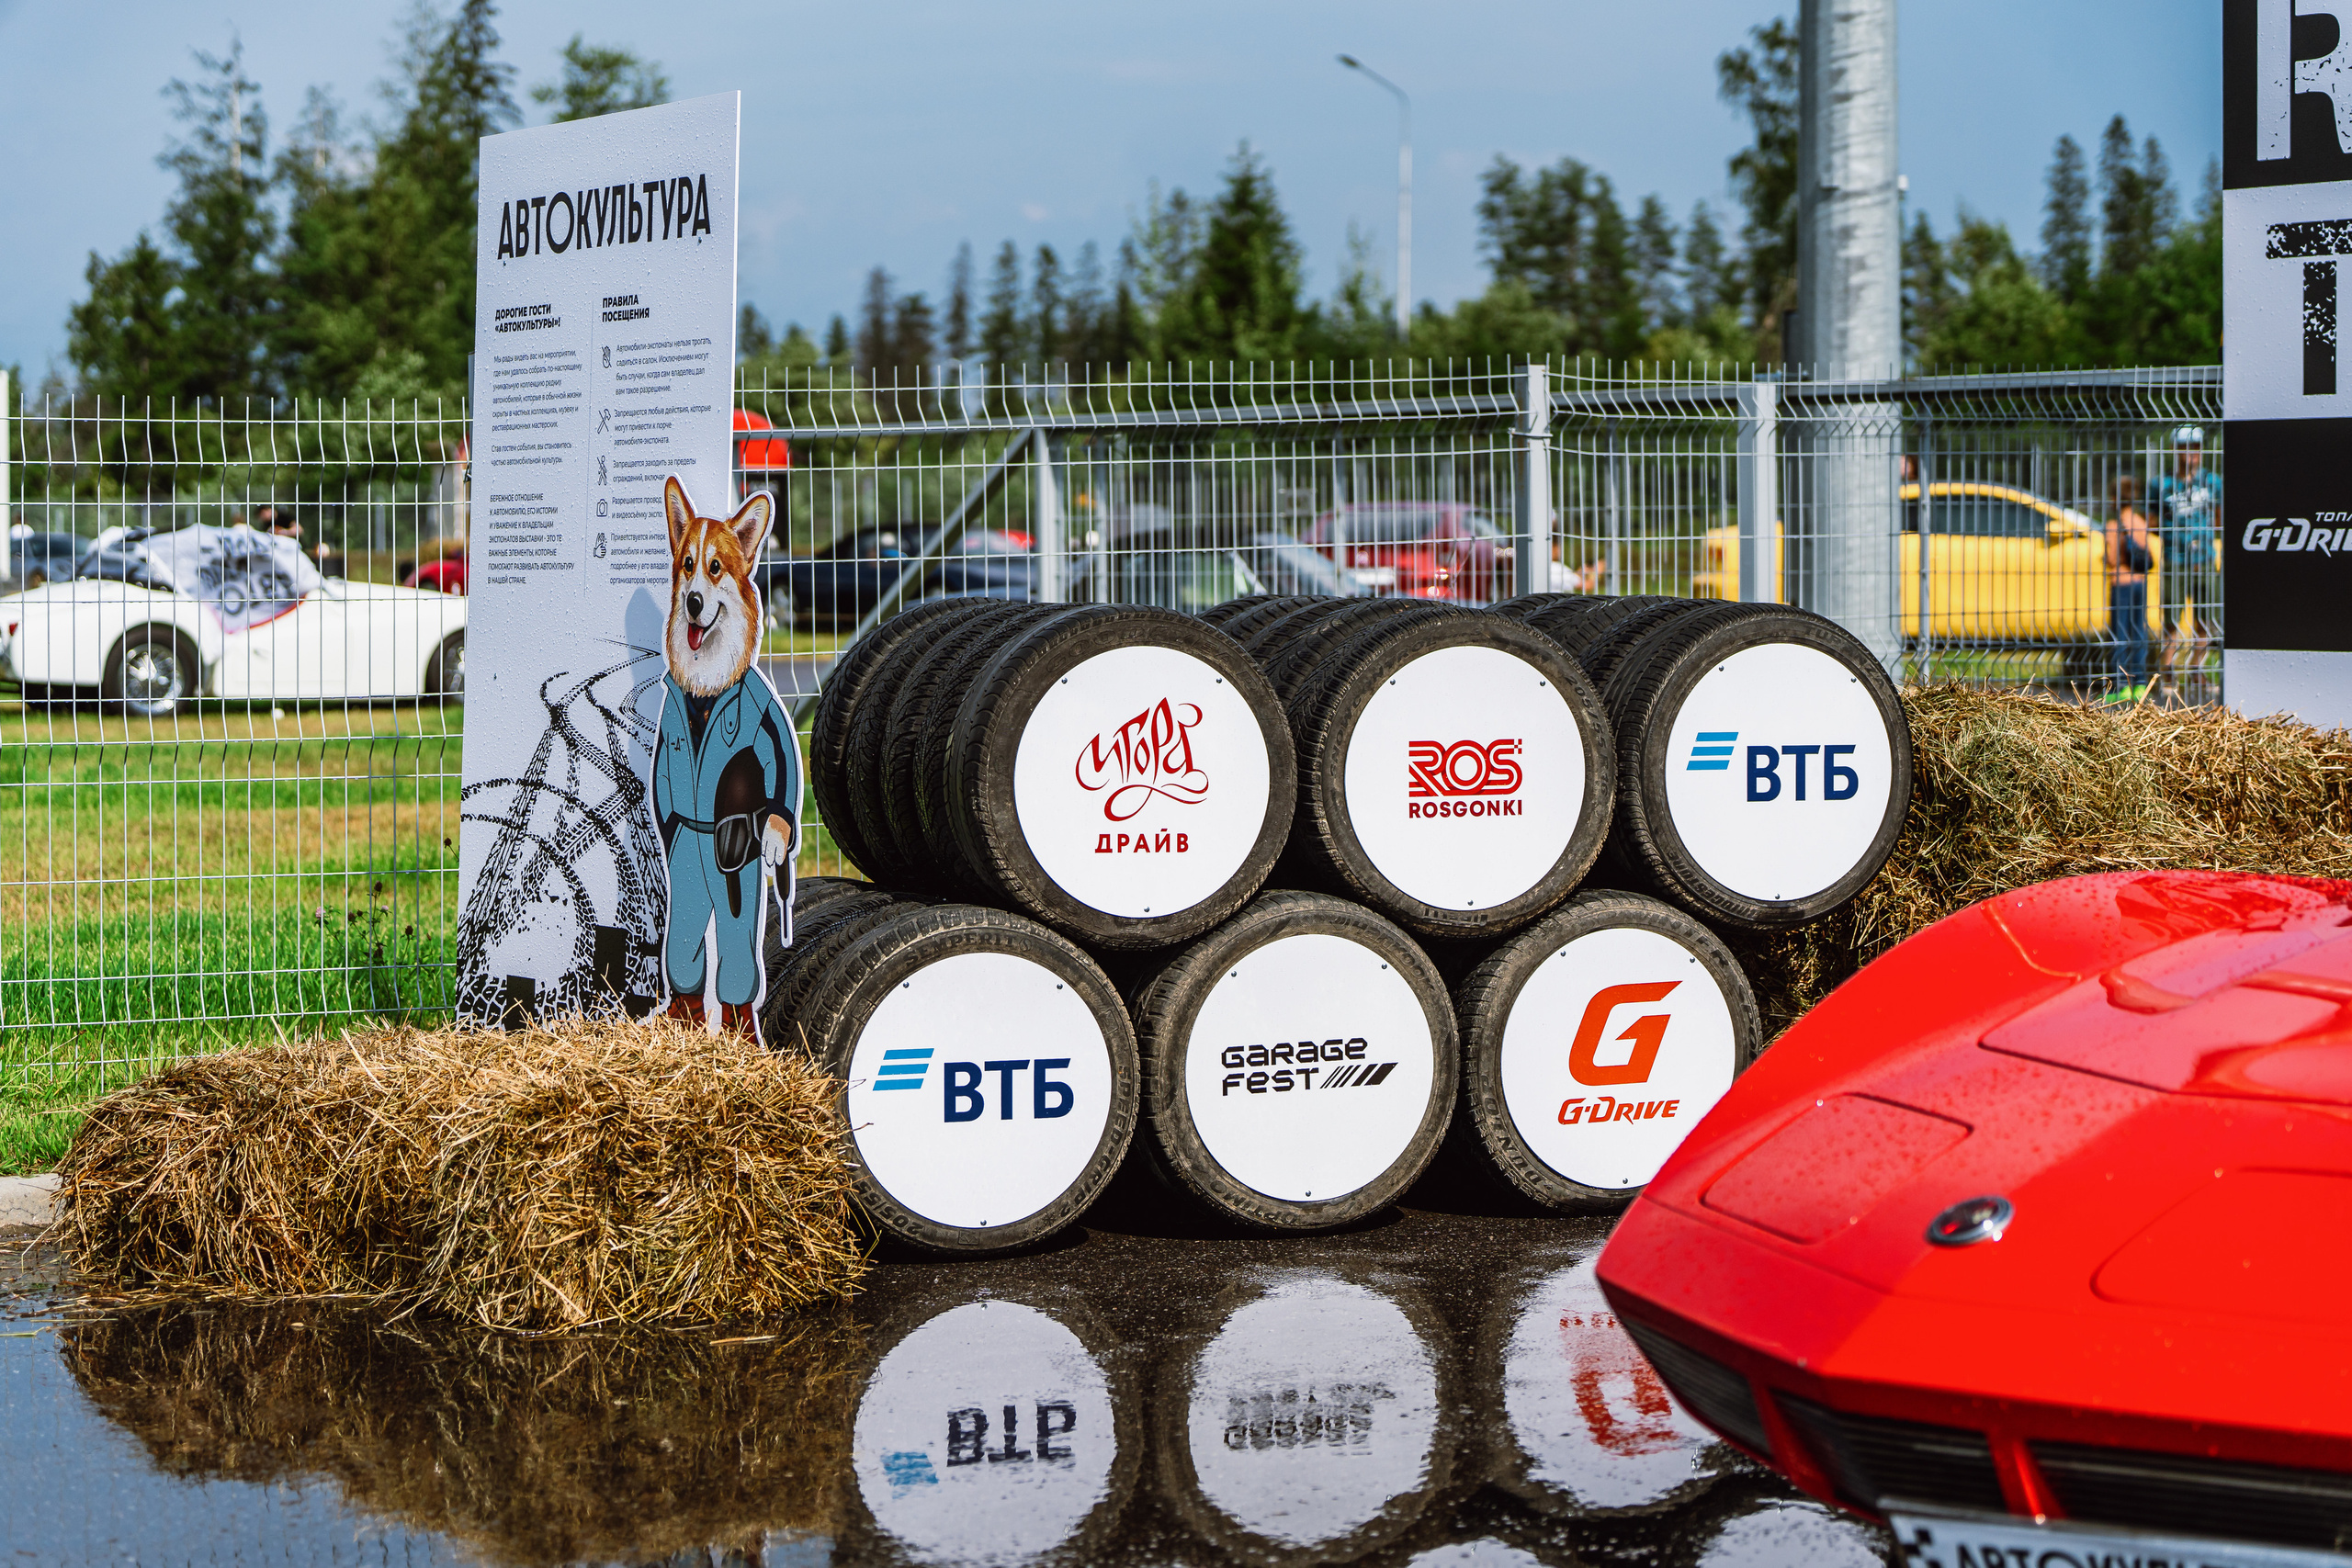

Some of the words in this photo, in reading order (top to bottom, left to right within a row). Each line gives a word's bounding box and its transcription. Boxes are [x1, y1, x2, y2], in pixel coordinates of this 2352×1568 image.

[497, 174, 710, 260] АВТОКУЛЬТУРА
[495, 307, 527, 321] ДОРОГИЕ
[529, 304, 550, 316] ГОСТИ
[603, 295, 639, 308] ПРАВИЛА
[603, 308, 650, 322] ПОСЕЩЕНИЯ
[495, 317, 560, 333] «АВТОКУЛЬТУРЫ»!
[1409, 739, 1522, 797] ROS
[1747, 744, 1859, 802] ВТБ
[1408, 800, 1522, 818] ROSGONKI
[1095, 829, 1189, 853] ДРАЙВ
[900, 931, 1016, 965] SEMPERIT
[944, 1058, 1074, 1122] ВТБ
[1069, 1064, 1131, 1206] SPEED-GRIP
[1479, 1075, 1545, 1189] DUNLOP
